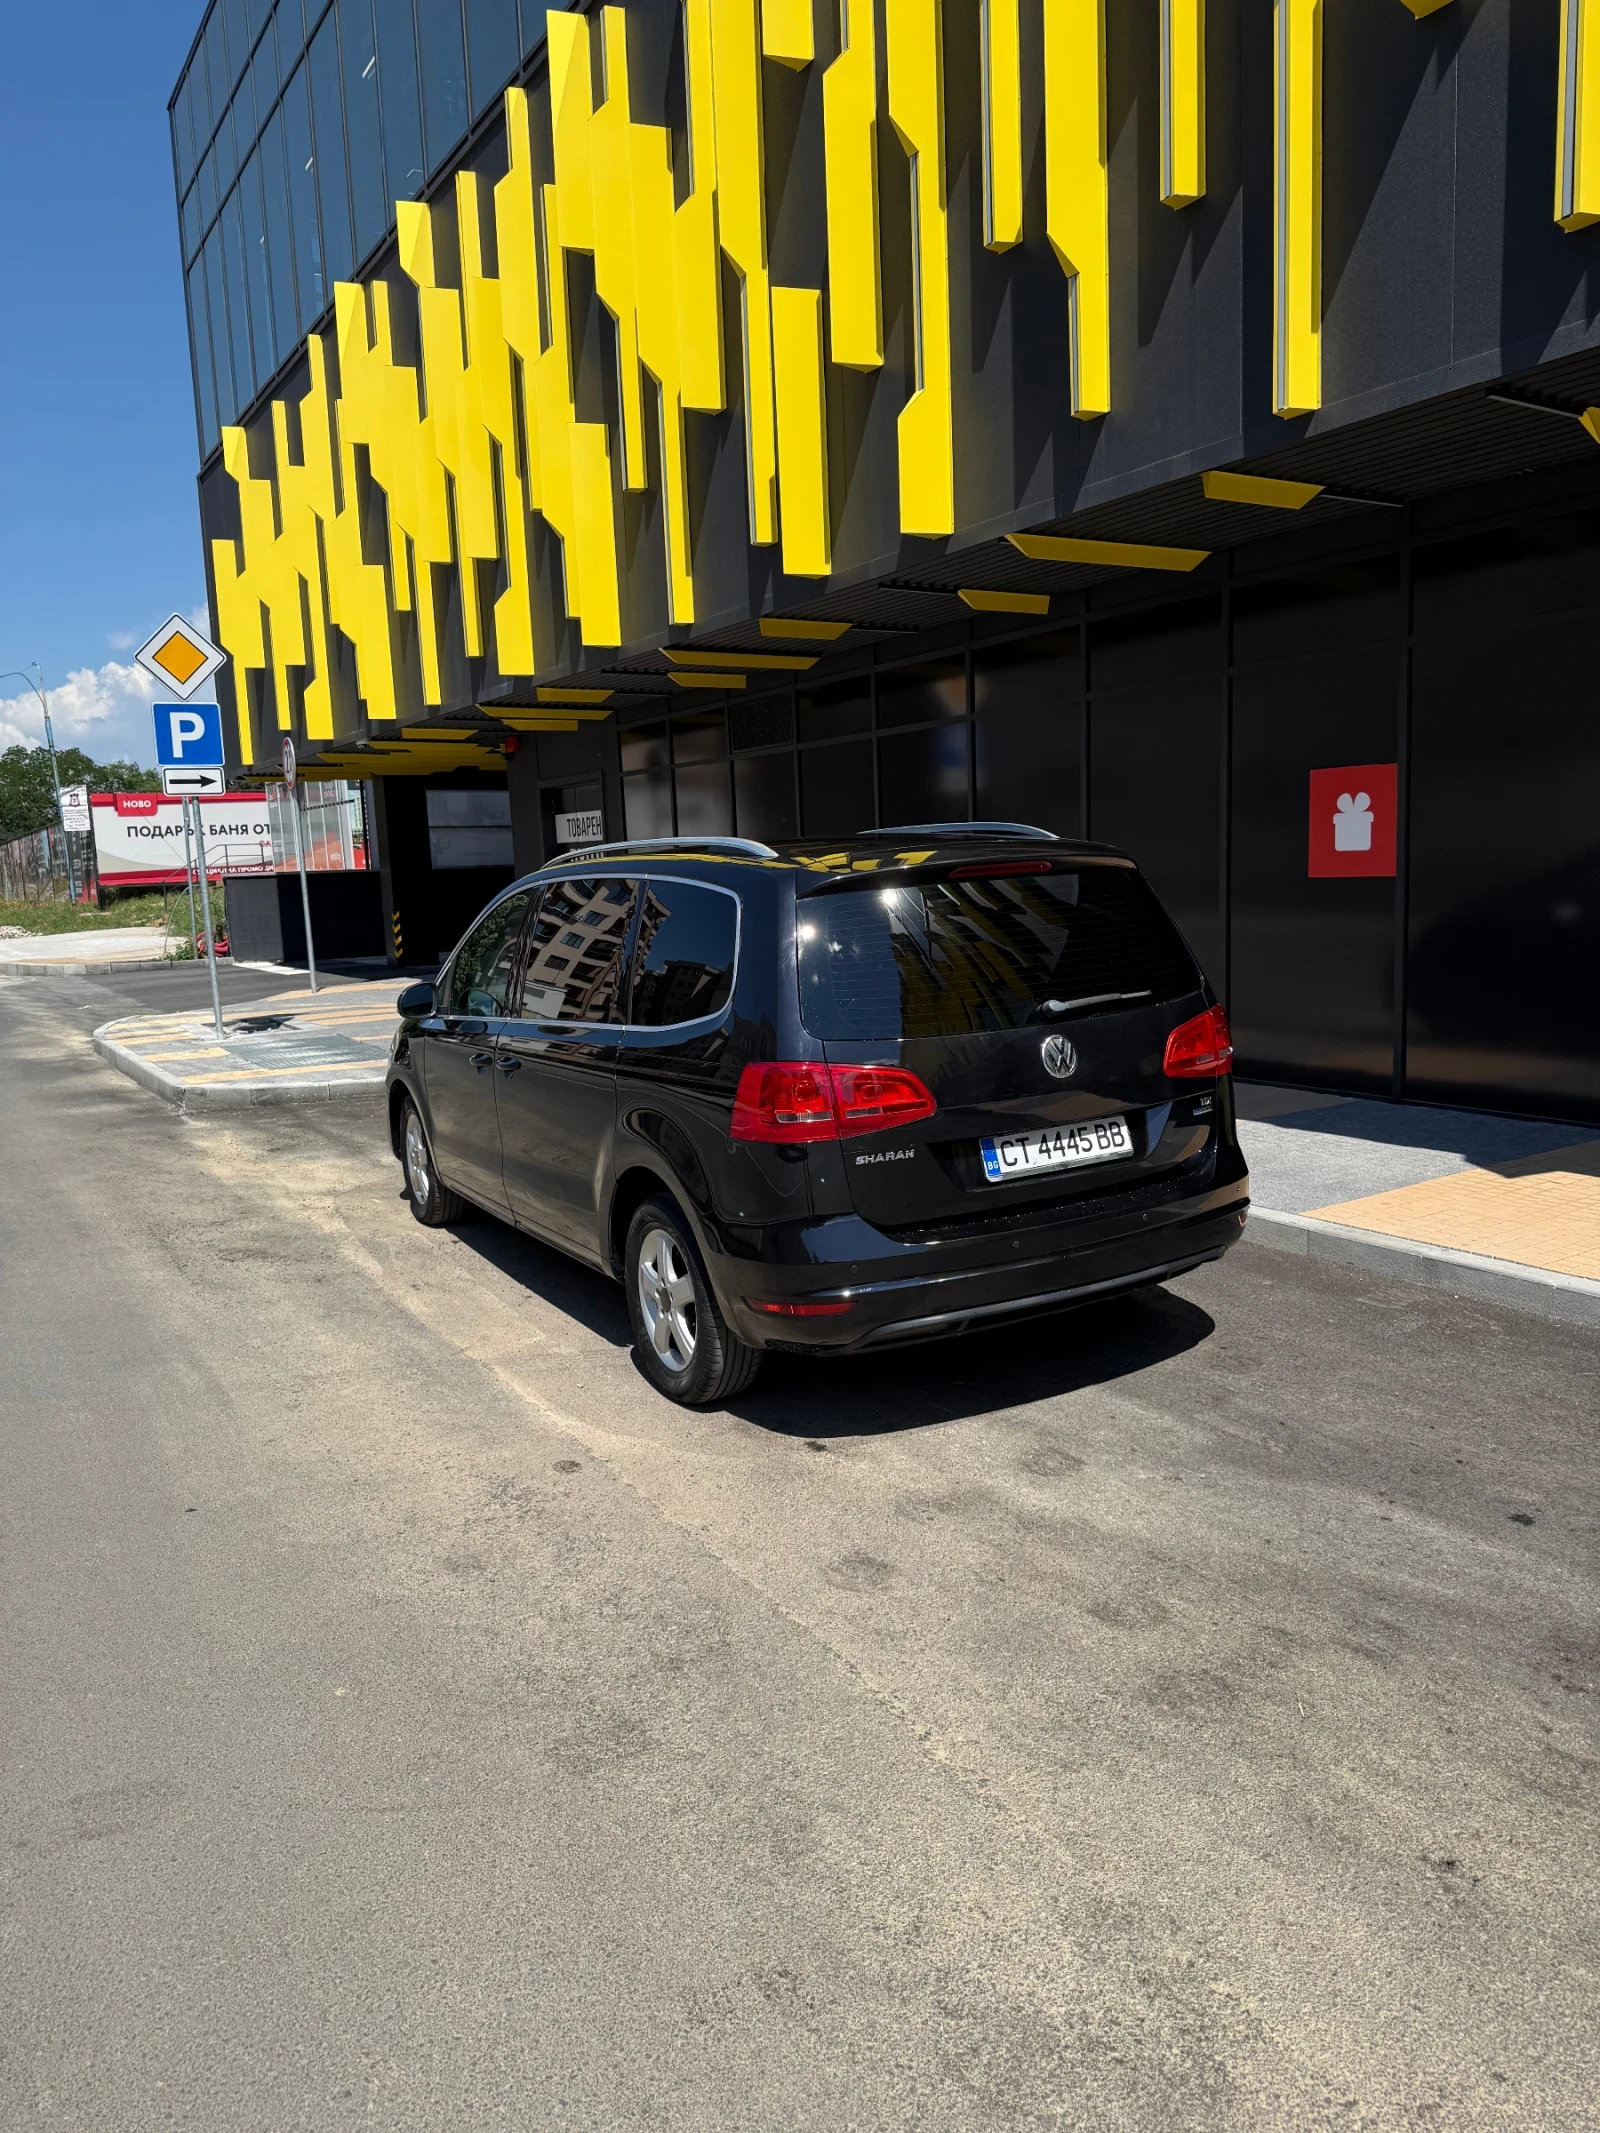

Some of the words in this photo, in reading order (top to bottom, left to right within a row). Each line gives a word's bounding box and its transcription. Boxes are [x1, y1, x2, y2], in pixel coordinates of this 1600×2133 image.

[169, 711, 205, 758] P
[123, 800, 152, 808] НОВО
[127, 824, 206, 839] ПОДАРЪ
[210, 824, 249, 835] БАНЯ
[566, 816, 602, 837] ТОВАРЕН
[237, 865, 263, 873] ПРОМО
[987, 1161, 999, 1170] BG
[1000, 1136, 1030, 1167] CT
[1038, 1126, 1093, 1160] 4445
[1093, 1121, 1126, 1150] BB
[855, 1149, 915, 1165] SHARAN
